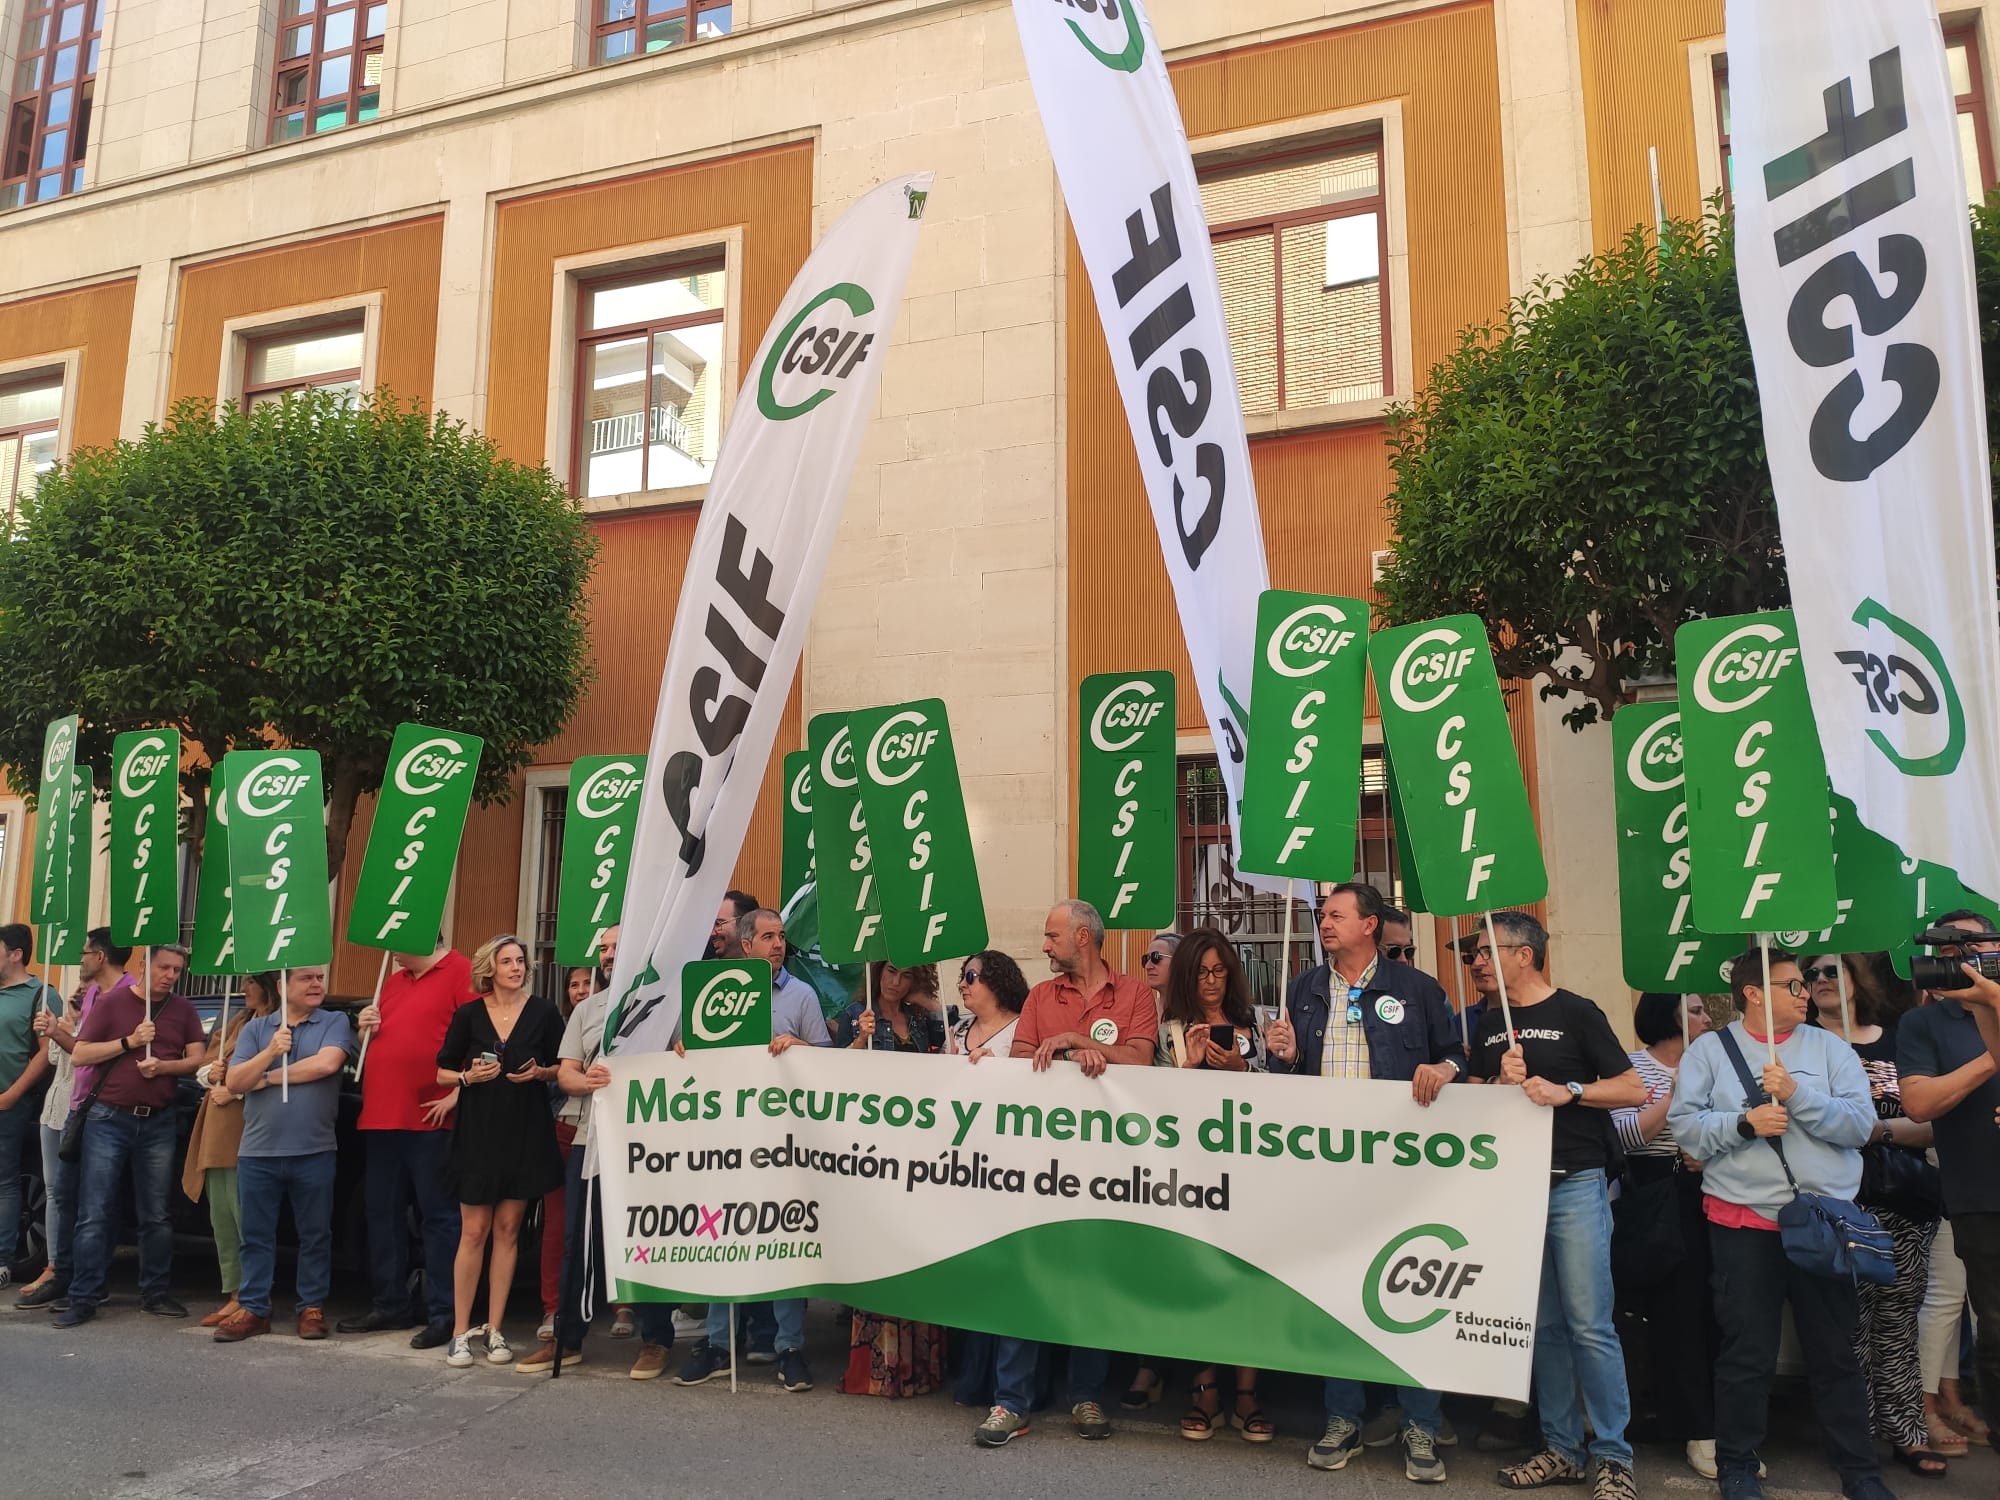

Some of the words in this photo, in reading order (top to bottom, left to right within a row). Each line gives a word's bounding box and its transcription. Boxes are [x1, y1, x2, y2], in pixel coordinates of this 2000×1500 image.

[782, 326, 874, 378] CSIF
[1109, 759, 1143, 918] CSIF
[1276, 690, 1326, 865] CSIF
[1436, 715, 1495, 901] CSIF
[1734, 720, 1781, 920] CSIF
[42, 787, 61, 916] CSIF
[133, 803, 155, 938] CSIF
[266, 823, 297, 961] CSIF
[375, 806, 436, 940] CSIF
[903, 790, 948, 953] CSIF
[626, 1076, 722, 1124] Más
[736, 1086, 936, 1129] recursos
[951, 1099, 982, 1146] y
[996, 1103, 1180, 1149] menos
[1198, 1098, 1499, 1170] discursos
[628, 1142, 680, 1174] Por
[686, 1147, 742, 1171] una
[750, 1134, 899, 1180] educación
[906, 1150, 1025, 1192] pública
[1033, 1159, 1081, 1198] de
[1089, 1166, 1230, 1211] calidad
[670, 1241, 751, 1263] EDUCACIÓN
[755, 1239, 822, 1261] PÚBLICA
[1455, 1311, 1531, 1332] Educación
[1455, 1328, 1530, 1349] Andalucí
